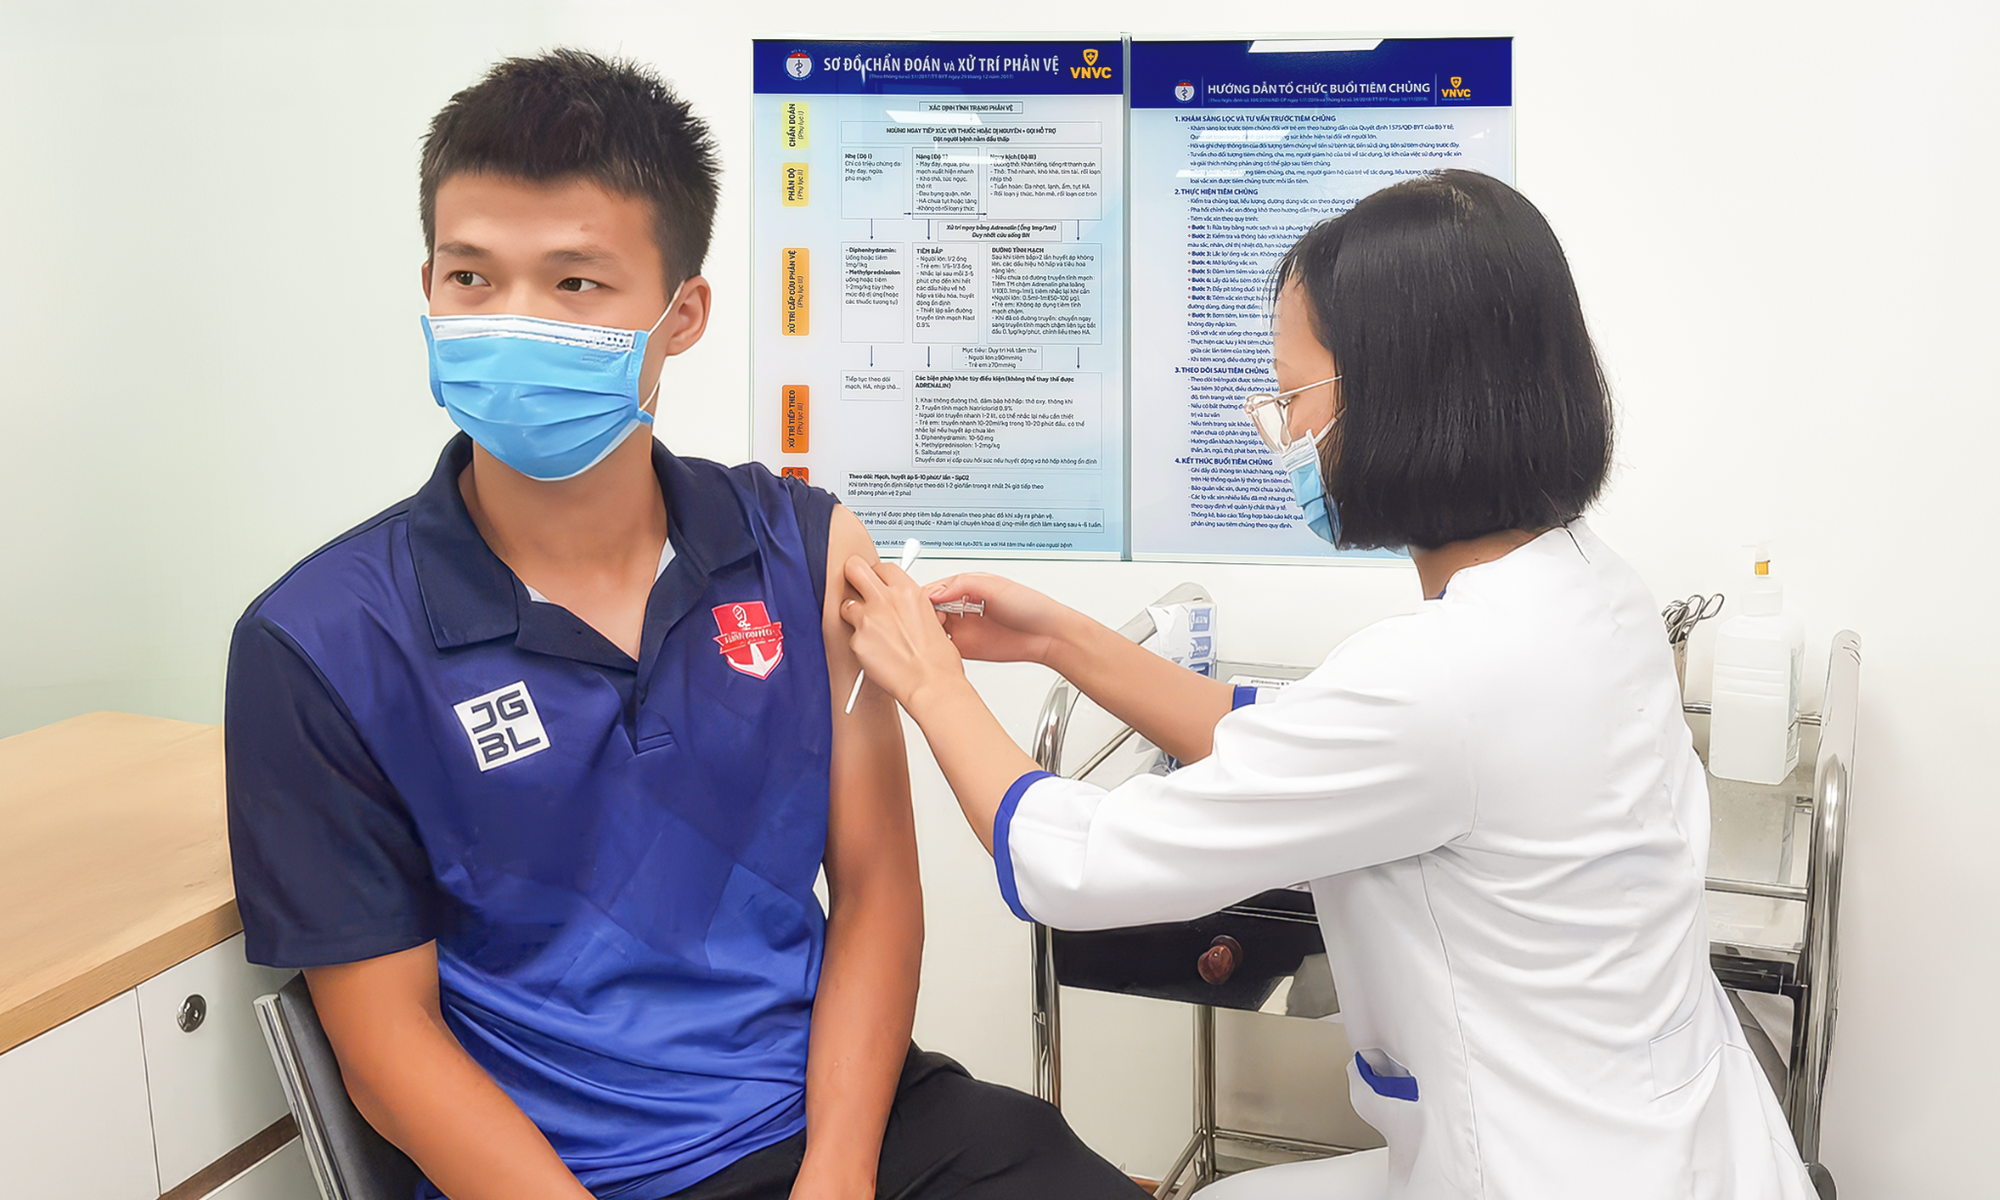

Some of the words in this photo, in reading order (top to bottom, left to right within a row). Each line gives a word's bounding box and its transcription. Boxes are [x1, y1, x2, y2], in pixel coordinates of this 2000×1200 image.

[824, 57, 841, 71] SƠ
[843, 54, 862, 71] ĐỒ
[865, 53, 900, 71] CHẨN
[904, 55, 940, 71] ĐOÁN
[957, 54, 976, 71] XỬ
[979, 55, 1001, 71] TRÍ
[1003, 54, 1040, 71] PHẢN
[1043, 55, 1059, 75] VỆ
[1070, 67, 1112, 79] VNVC
[1208, 83, 1250, 94] HƯỚNG
[1252, 81, 1277, 94] DẪN
[1278, 81, 1294, 94] TỔ
[1295, 82, 1327, 93] CHỨC
[1329, 80, 1358, 93] BUỔI
[1359, 81, 1387, 93] TIÊM
[1388, 80, 1430, 93] CHỦNG
[1441, 89, 1472, 97] VNVC
[1181, 115, 1201, 123] KHÁM
[1221, 114, 1235, 122] LỌC
[1255, 114, 1270, 122] VẤN
[1270, 114, 1293, 122] TRƯỚC
[1293, 114, 1310, 122] TIÊM
[1310, 114, 1336, 122] CHỦNG
[1180, 188, 1199, 196] THỰC
[1200, 188, 1216, 196] HIỆN
[1216, 188, 1233, 196] TIÊM
[1213, 457, 1231, 465] BUỔI
[1231, 457, 1247, 465] TIÊM
[471, 689, 529, 734] JG
[477, 726, 541, 764] BL
